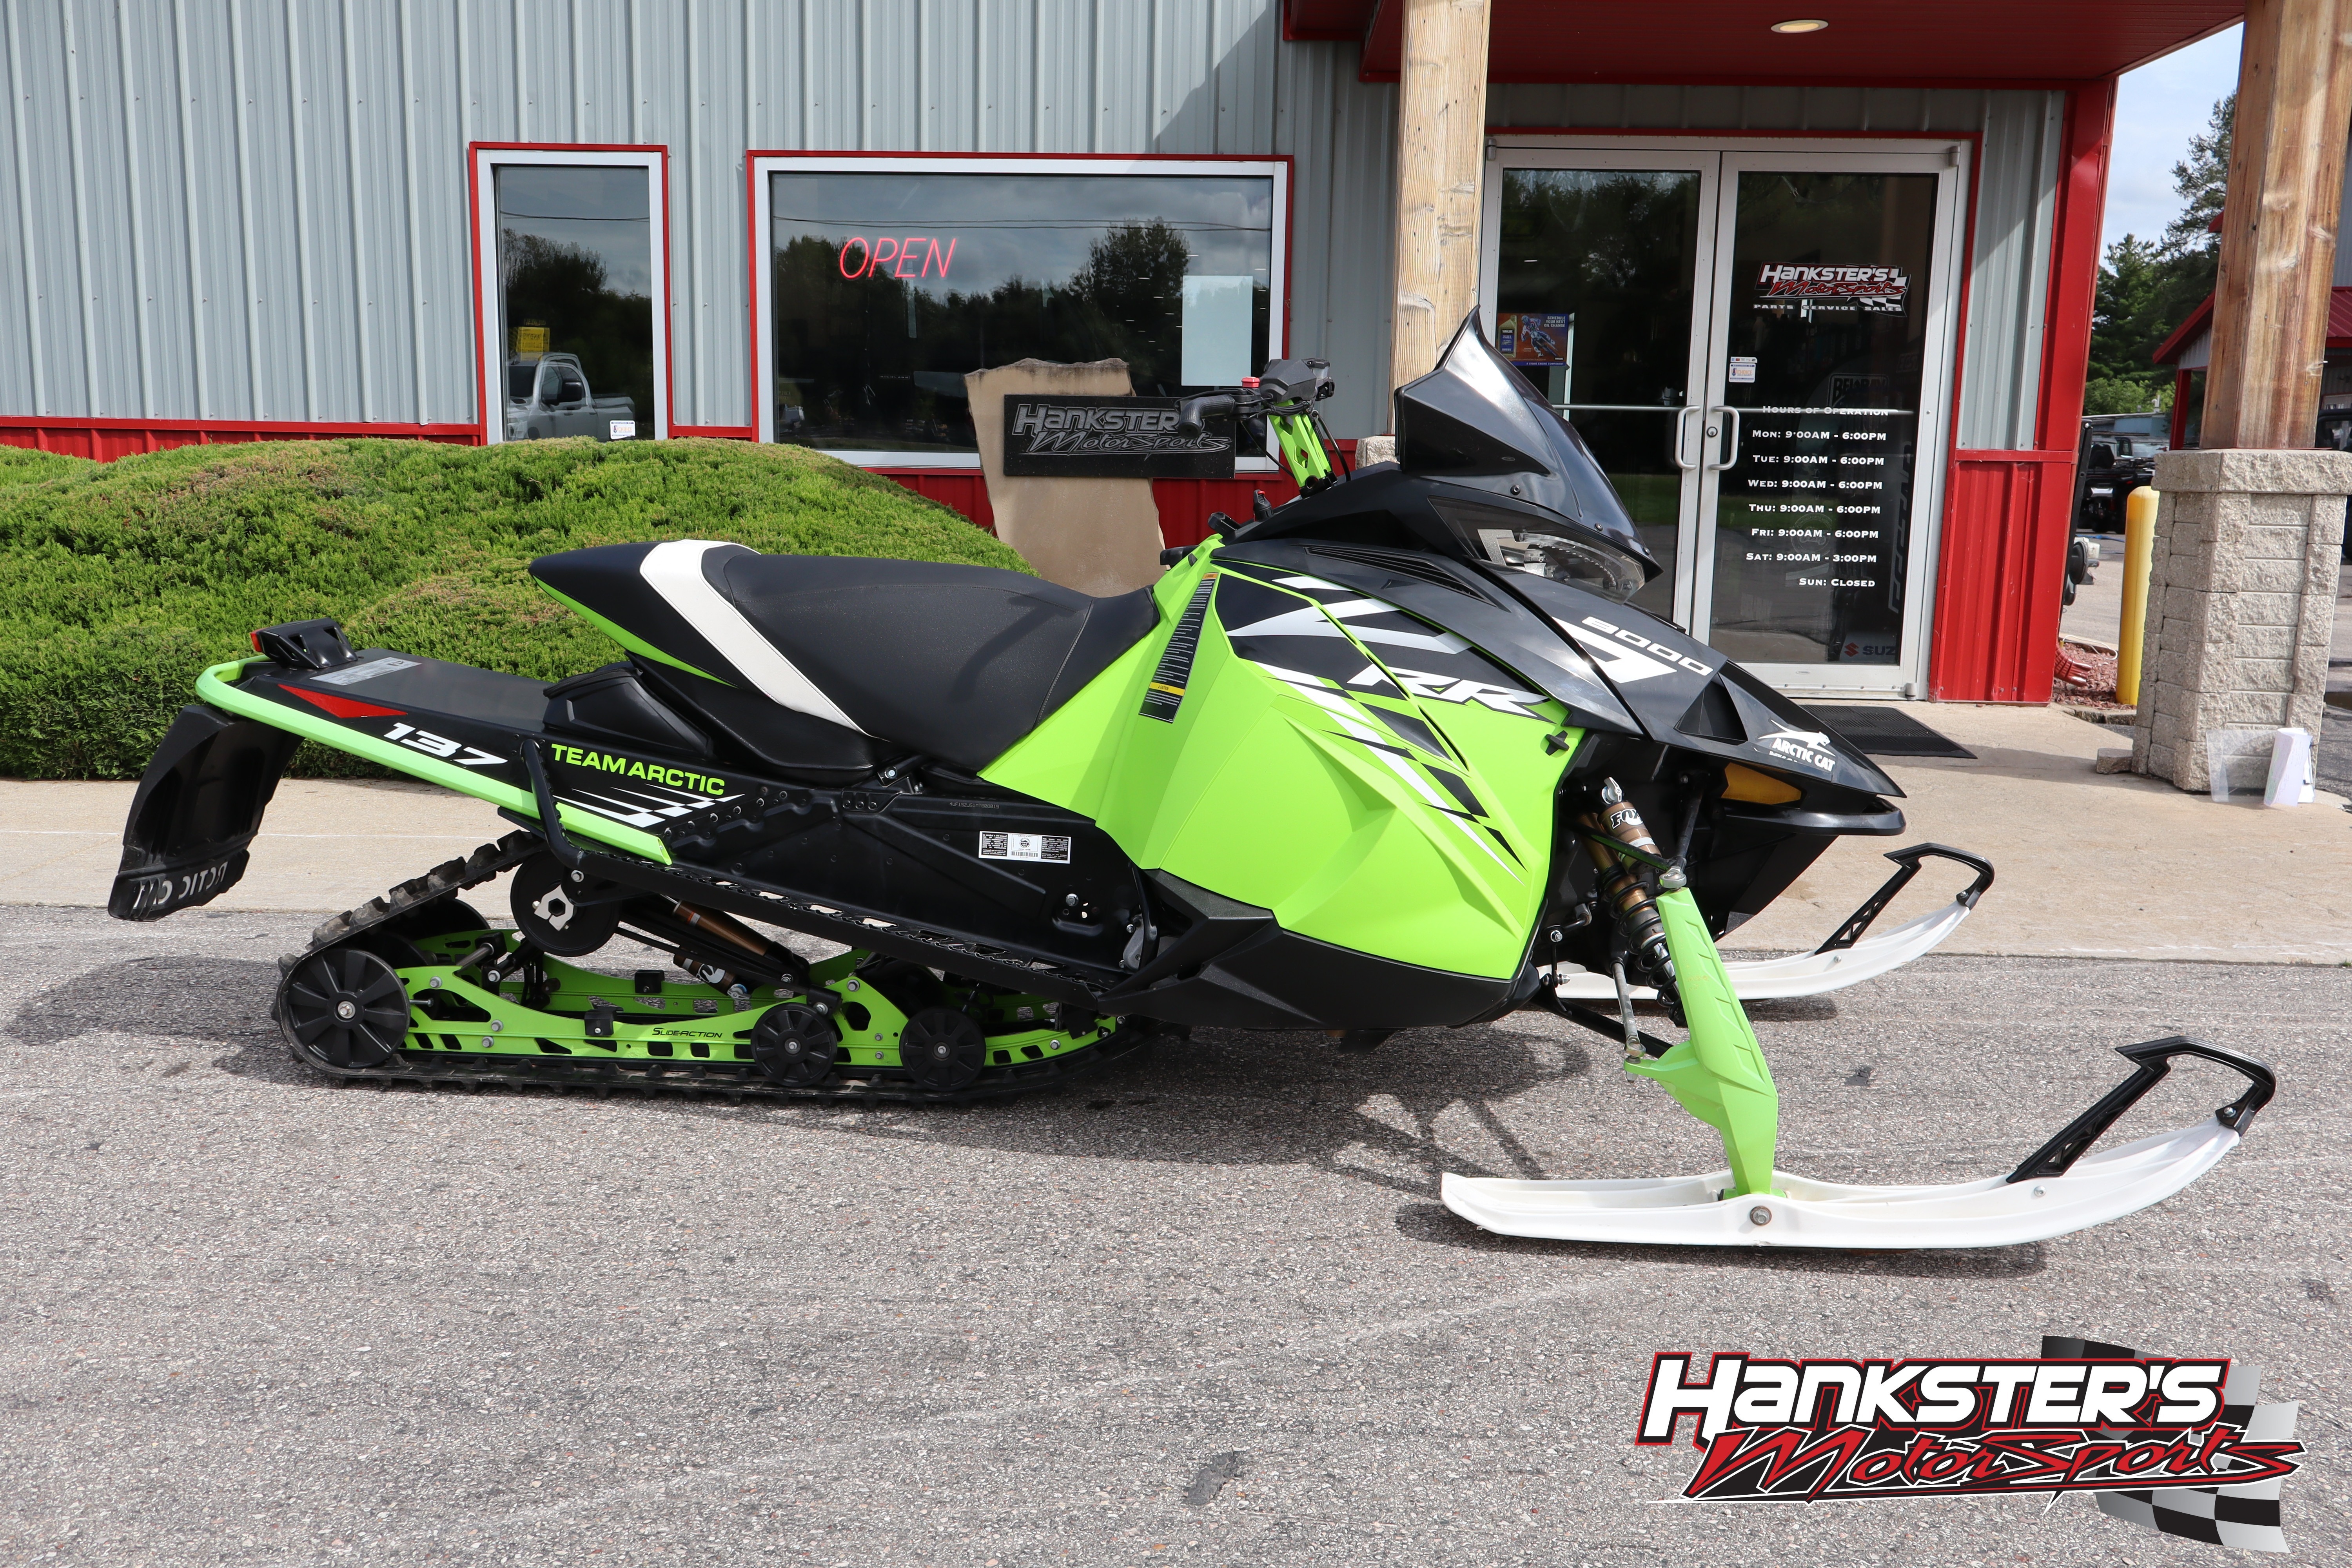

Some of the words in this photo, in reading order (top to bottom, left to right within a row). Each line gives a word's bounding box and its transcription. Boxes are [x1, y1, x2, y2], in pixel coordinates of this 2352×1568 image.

[840, 237, 957, 279] OPEN
[1842, 432, 1886, 441] 6:00PM
[1784, 456, 1828, 464] 9:00AM
[1840, 457, 1884, 465] 6:00PM
[1782, 480, 1826, 488] 9:00AM
[1838, 481, 1882, 489] 6:00PM
[1780, 505, 1824, 513] 9:00AM
[1837, 506, 1880, 514] 6:00PM
[1778, 529, 1822, 537] 9:00AM
[1835, 530, 1878, 538] 6:00PM
[1777, 553, 1820, 561] 9:00AM
[1833, 554, 1877, 563] 3:00PM
[383, 722, 508, 766] 137
[1772, 737, 1814, 763] ARCTIC
[1814, 754, 1836, 771] CAT
